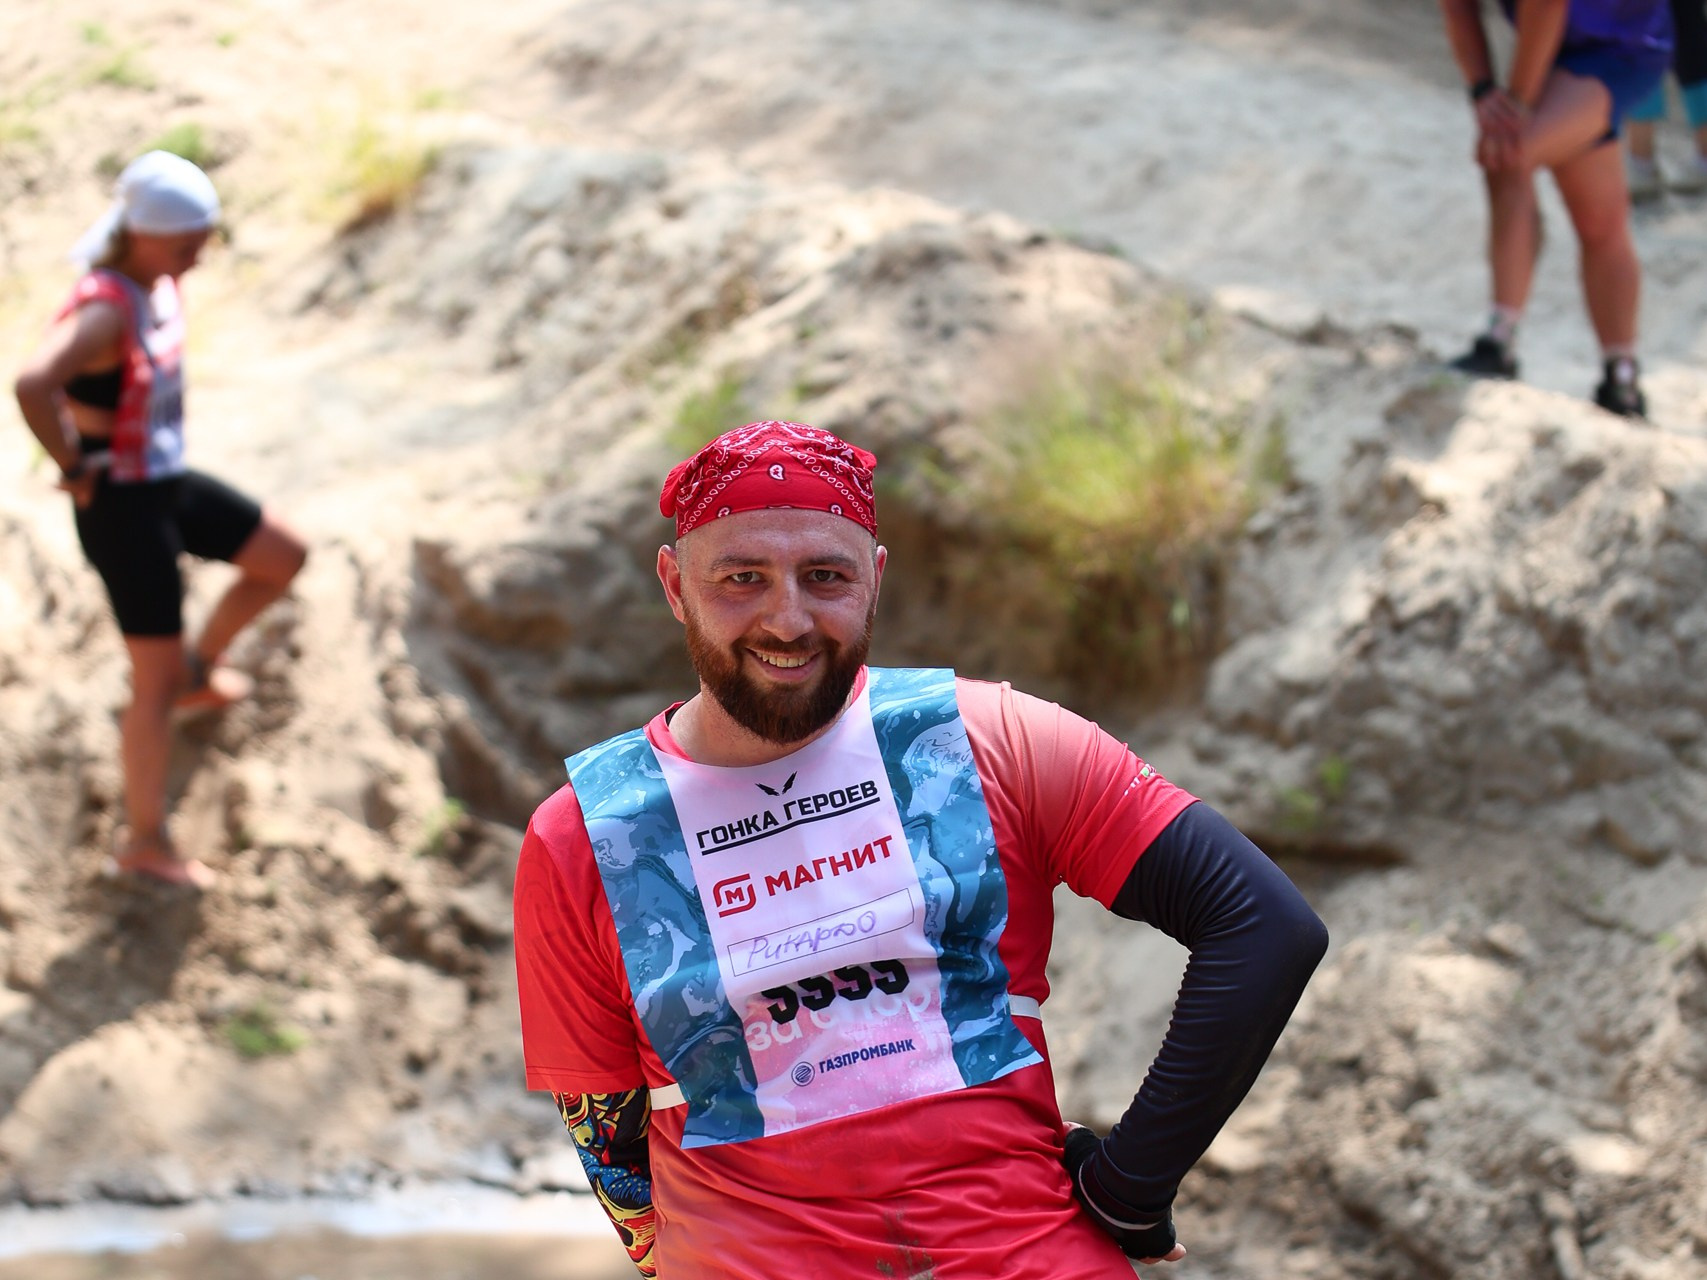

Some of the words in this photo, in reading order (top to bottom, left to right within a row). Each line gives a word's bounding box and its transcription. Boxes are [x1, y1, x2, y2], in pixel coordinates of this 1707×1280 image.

[696, 810, 779, 849] ГОНКА
[783, 780, 878, 820] ГЕРОЕВ
[764, 835, 892, 896] МАГНИТ
[819, 1038, 916, 1073] ГАЗПРОМБАНК
